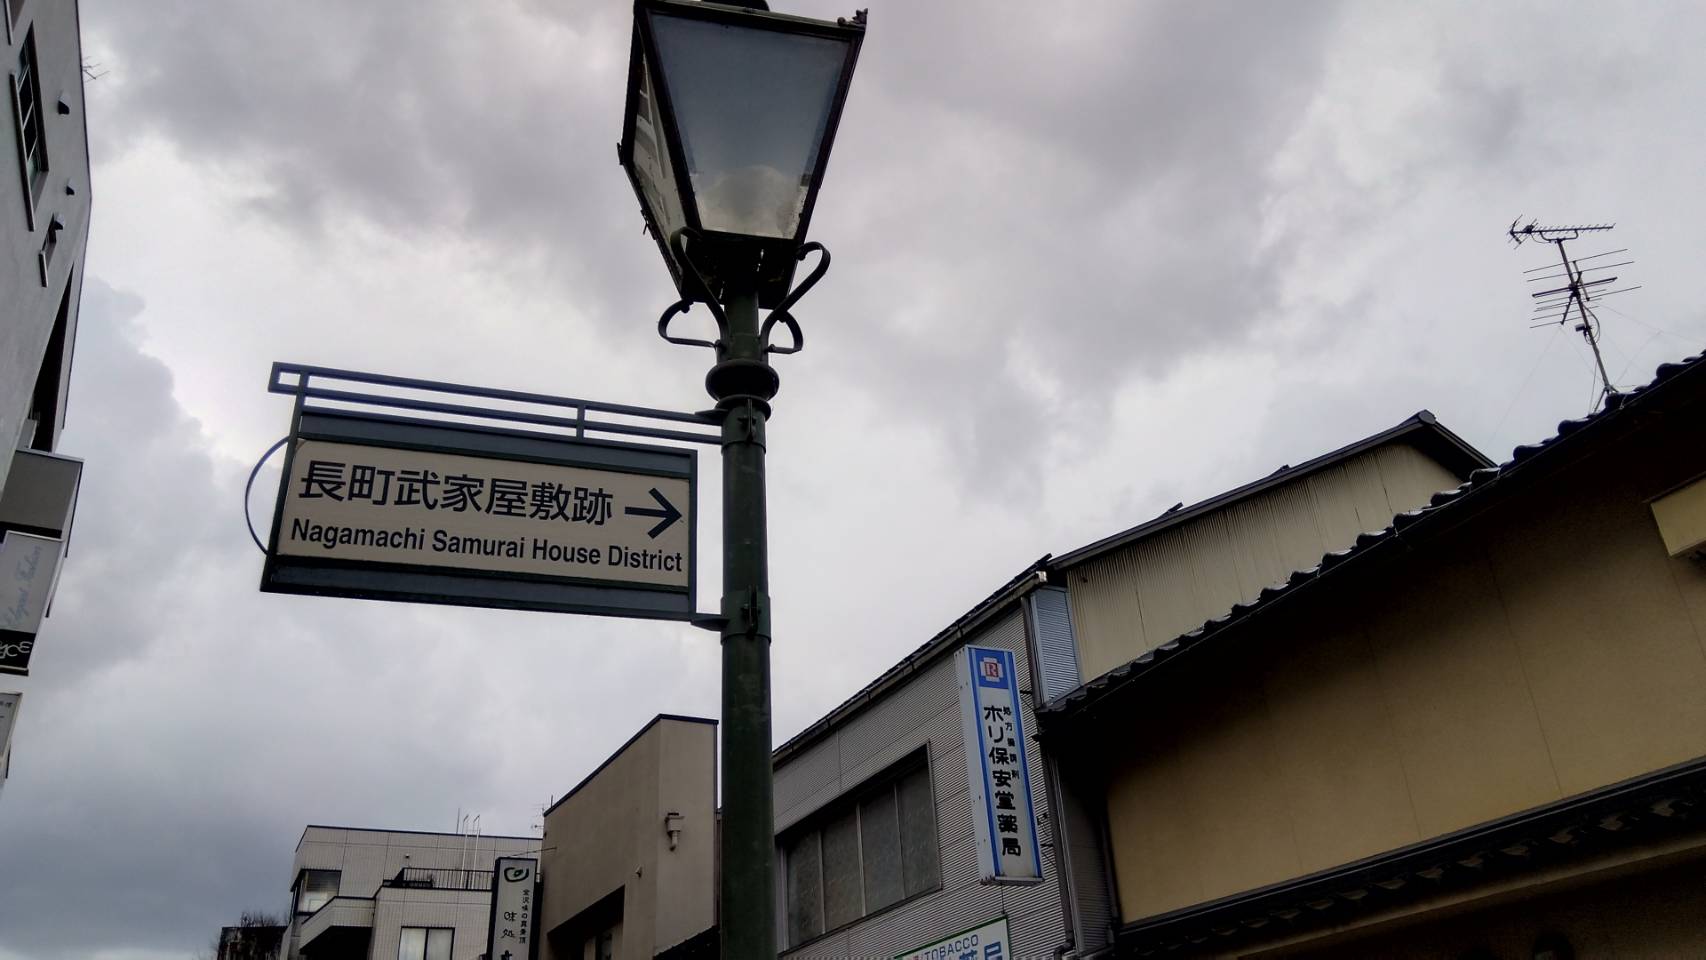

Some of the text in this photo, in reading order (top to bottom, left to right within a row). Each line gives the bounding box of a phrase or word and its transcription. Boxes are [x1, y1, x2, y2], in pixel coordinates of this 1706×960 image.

[297, 459, 615, 526] 長町武家屋敷跡
[291, 518, 683, 572] Nagamachi Samurai House District
[984, 706, 1021, 856] ホリ保安堂薬局
[924, 935, 979, 960] TOBACCO
